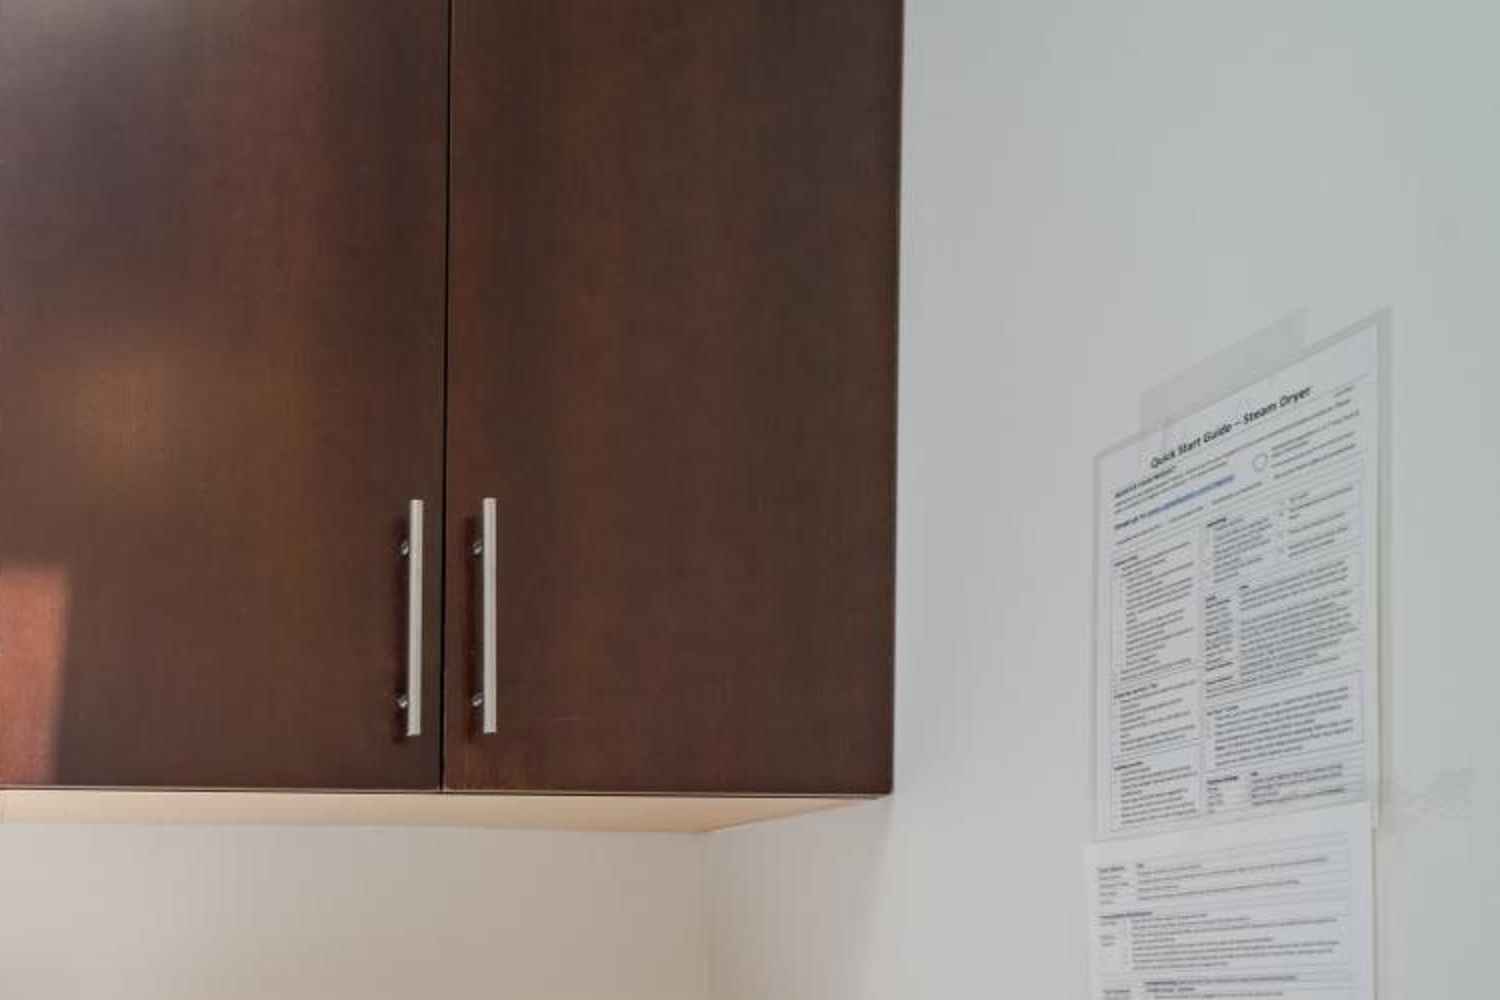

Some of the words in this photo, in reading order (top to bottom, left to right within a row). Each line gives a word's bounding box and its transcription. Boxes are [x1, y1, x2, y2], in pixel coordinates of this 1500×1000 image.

[1150, 450, 1176, 469] Quick
[1178, 437, 1201, 455] Start
[1203, 423, 1232, 443] Guide
[1243, 402, 1276, 425] Steam
[1279, 386, 1311, 408] Dryer
